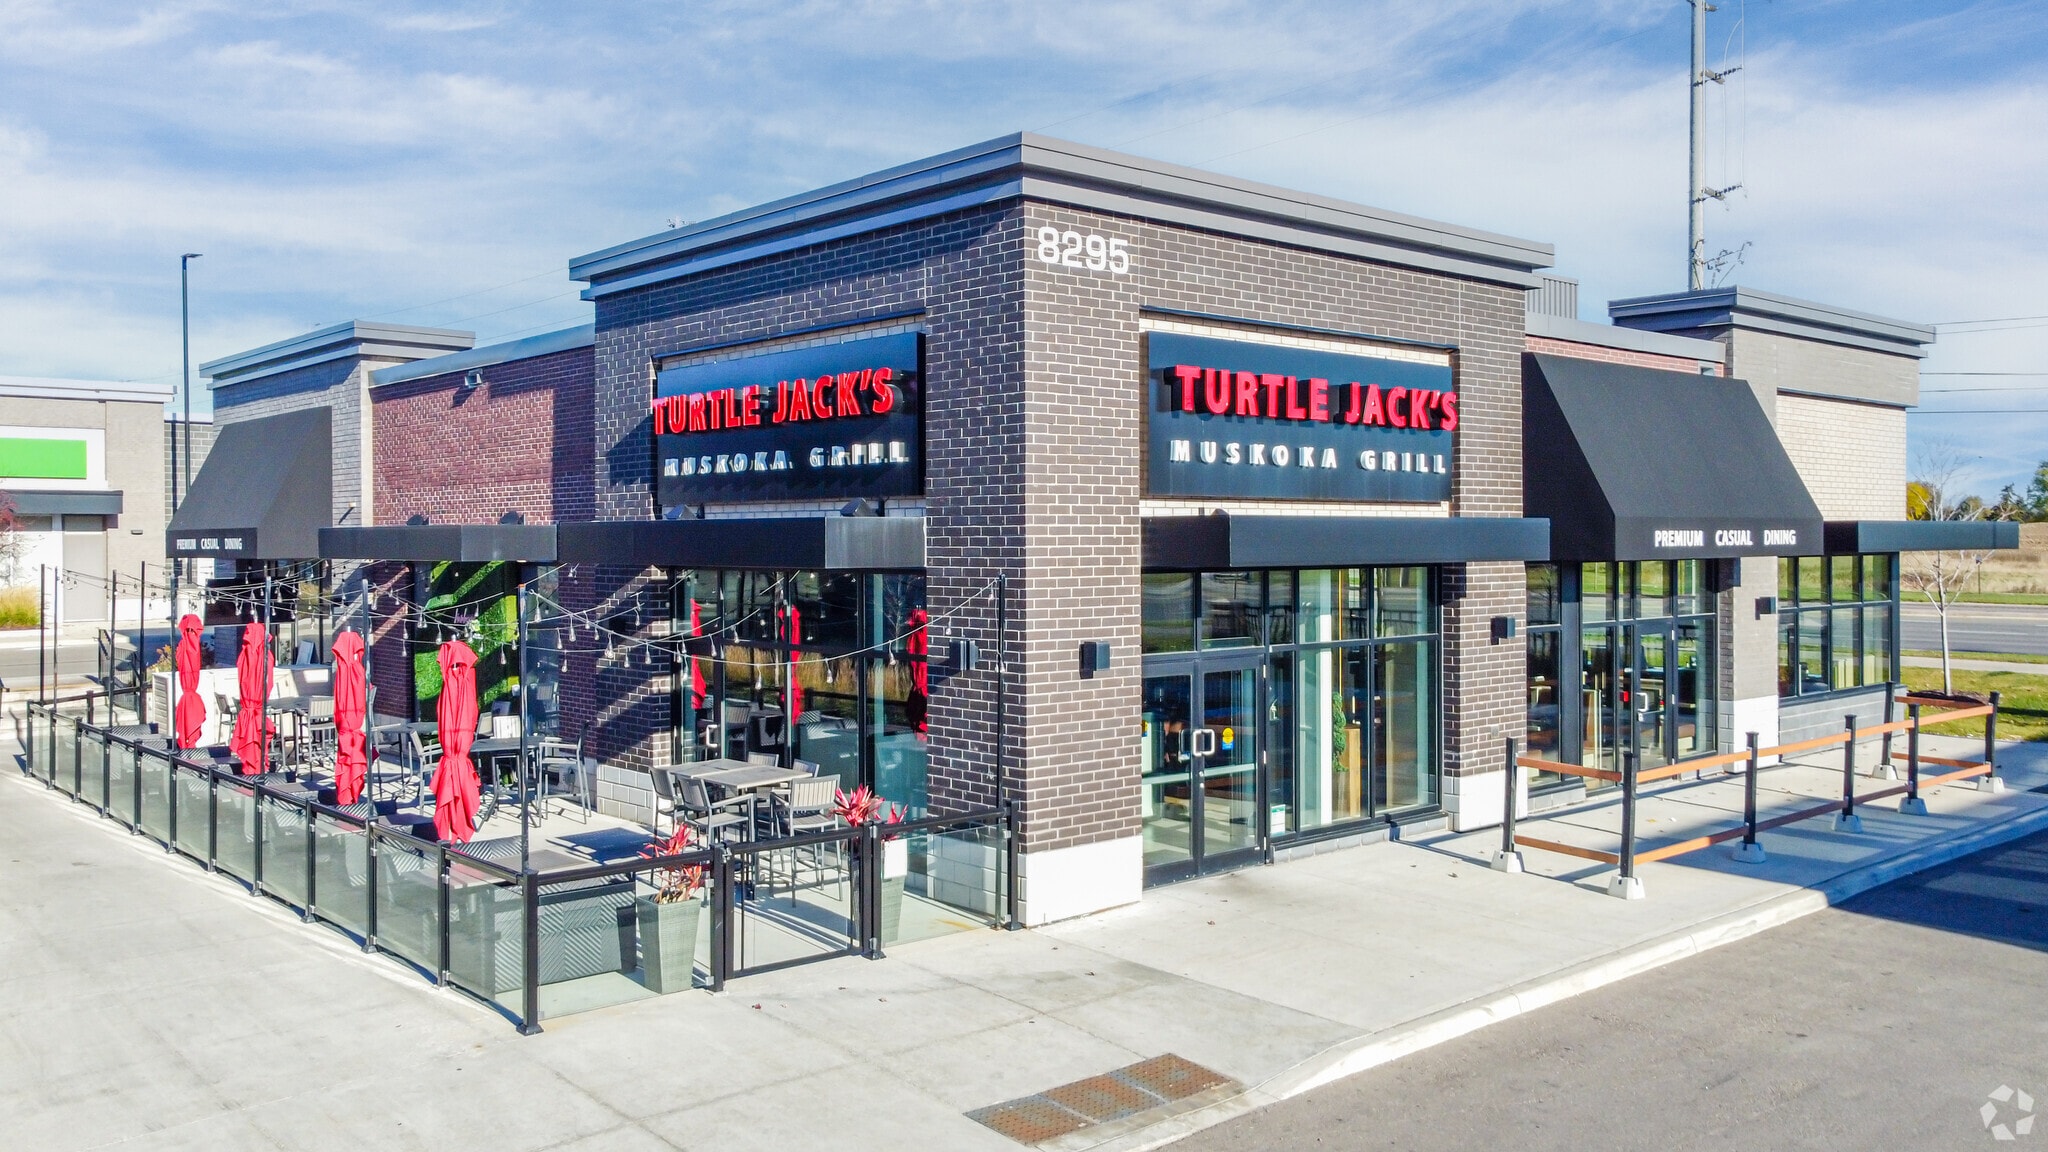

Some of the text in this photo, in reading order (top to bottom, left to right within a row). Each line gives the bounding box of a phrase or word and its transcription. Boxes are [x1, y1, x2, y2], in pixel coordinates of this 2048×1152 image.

[1038, 227, 1129, 274] 8295
[652, 367, 895, 435] TURTLE JACK'S
[1175, 364, 1458, 431] TURTLE JACK'S
[663, 441, 907, 477] MUSKOKA GRILL
[1170, 439, 1446, 474] MUSKOKA GRILL
[200, 537, 220, 550] CASUAL
[224, 537, 243, 550] DINING
[1654, 529, 1797, 547] PREMIUM CASUAL DINING
